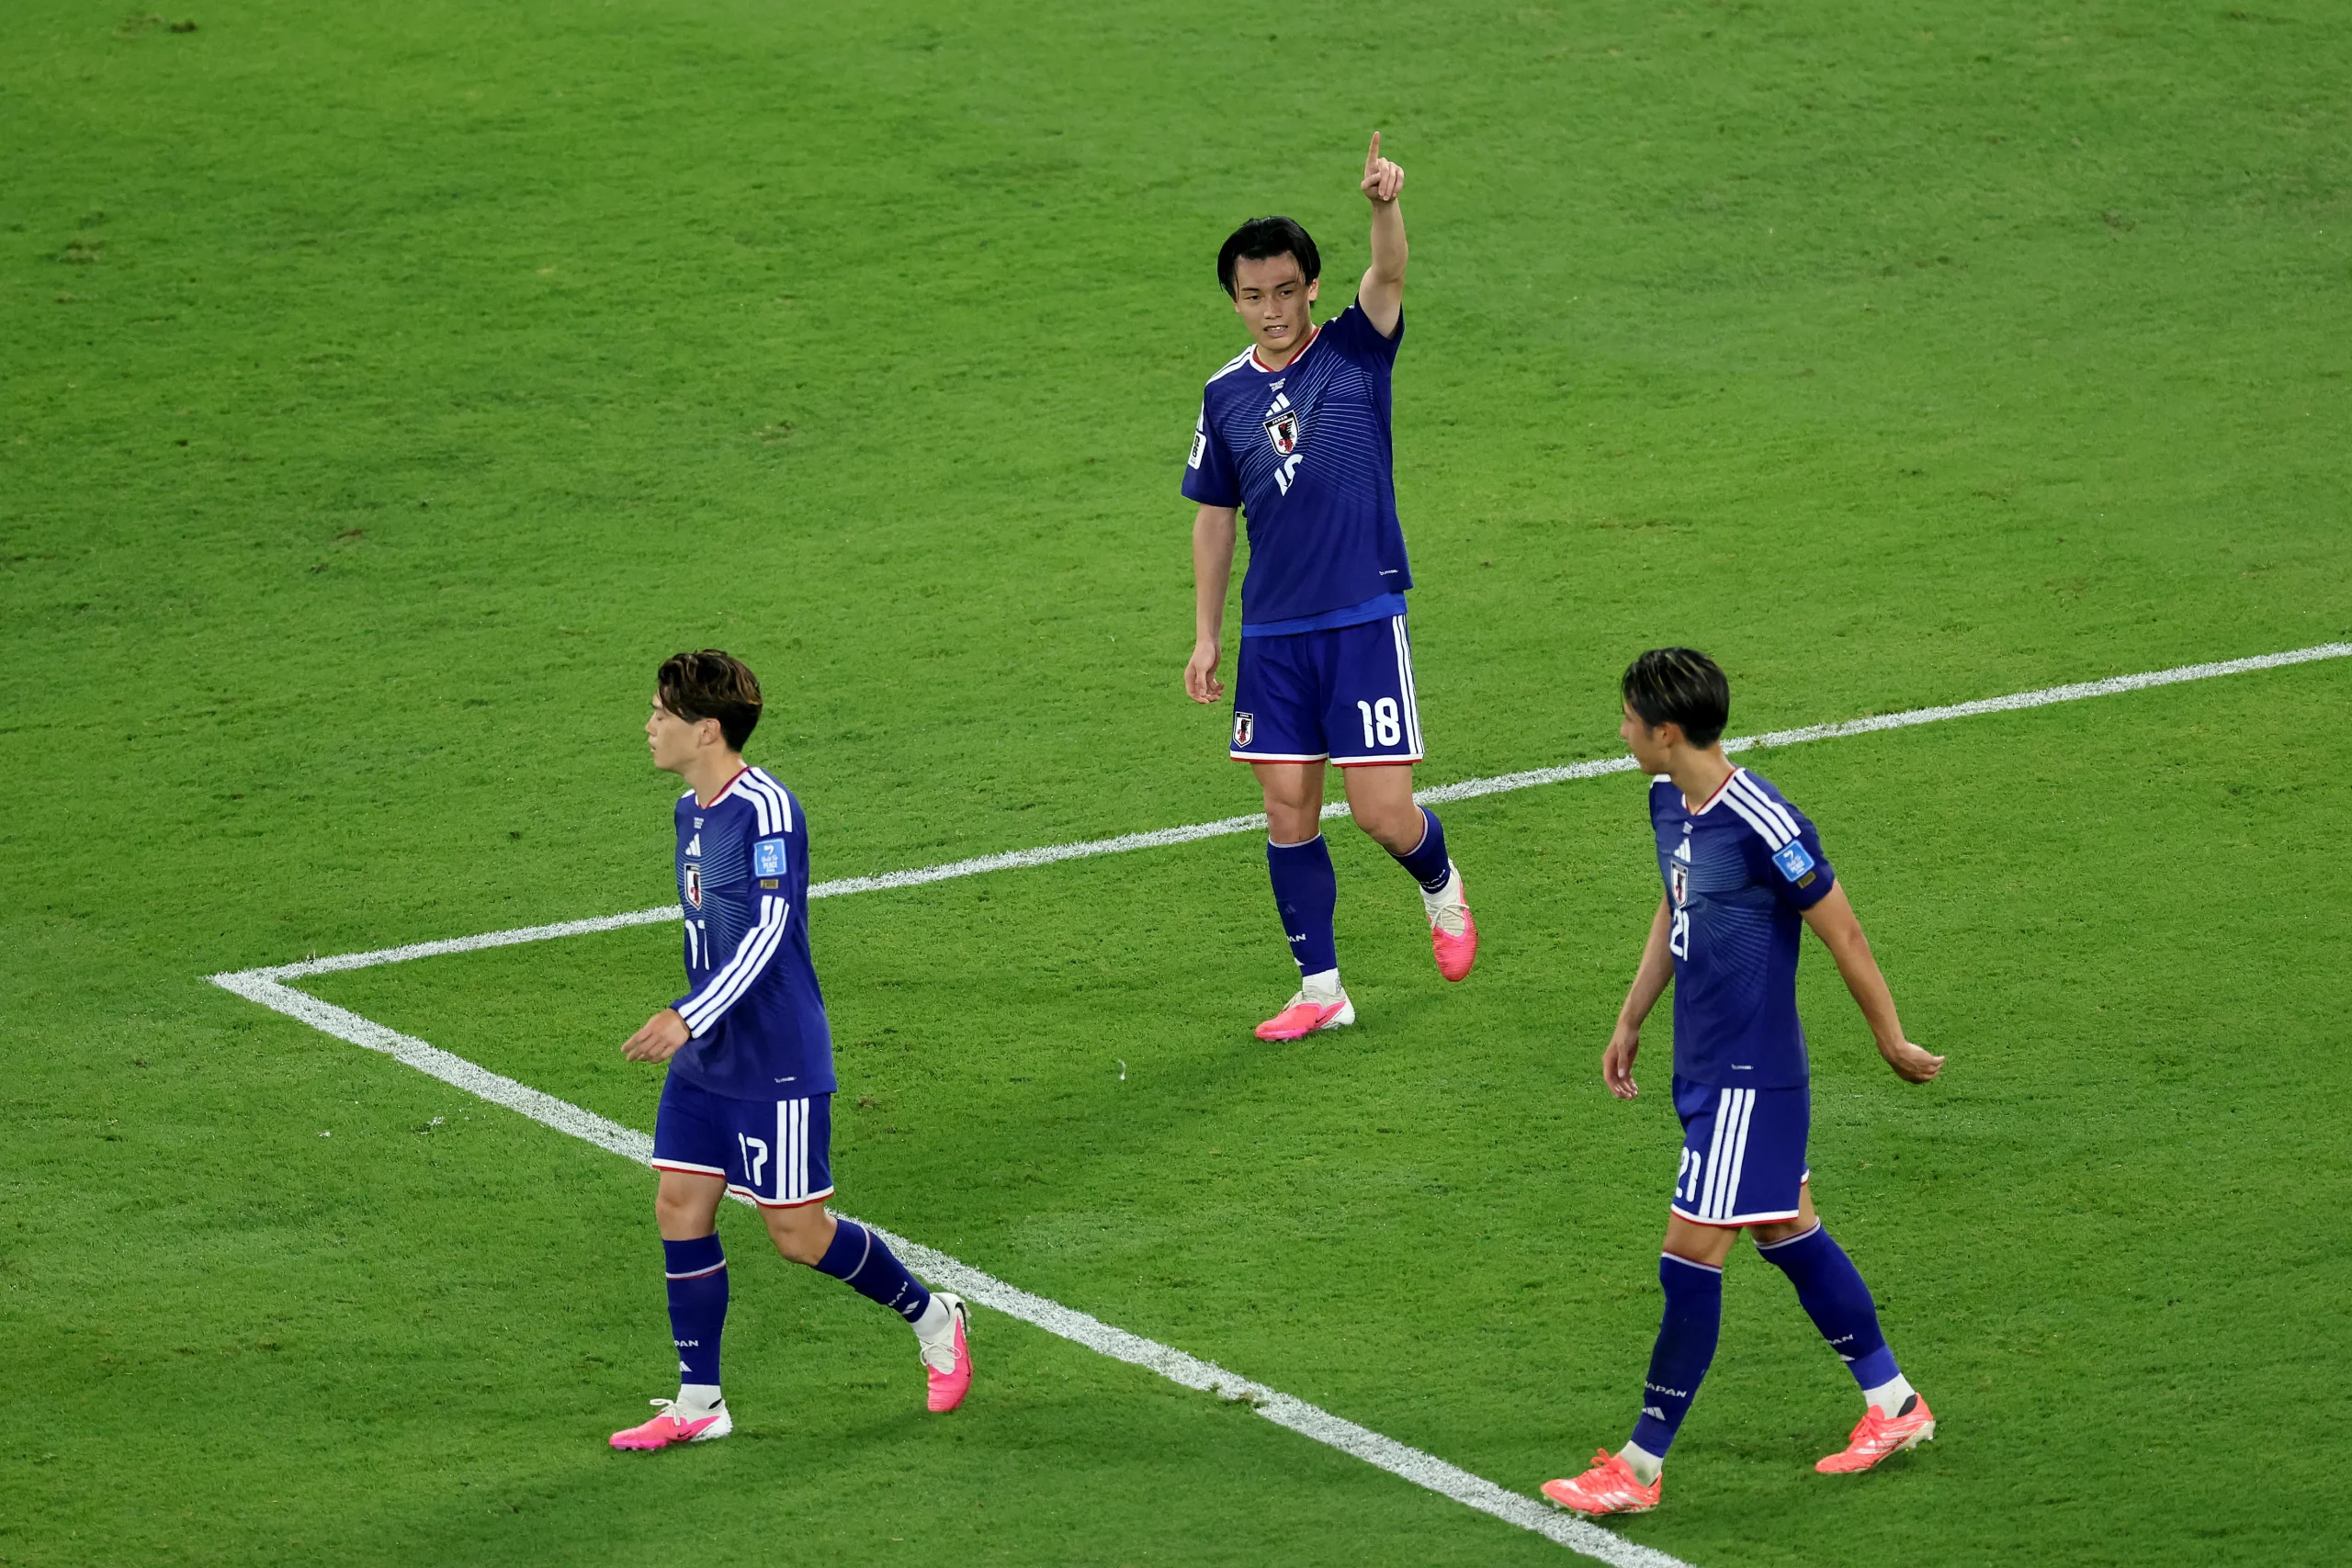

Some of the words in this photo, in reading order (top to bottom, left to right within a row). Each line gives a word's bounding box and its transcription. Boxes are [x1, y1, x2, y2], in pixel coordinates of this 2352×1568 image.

[1357, 696, 1401, 749] 18
[1669, 908, 1690, 962] 21
[738, 1132, 768, 1187] 17
[1676, 1146, 1702, 1202] 21
